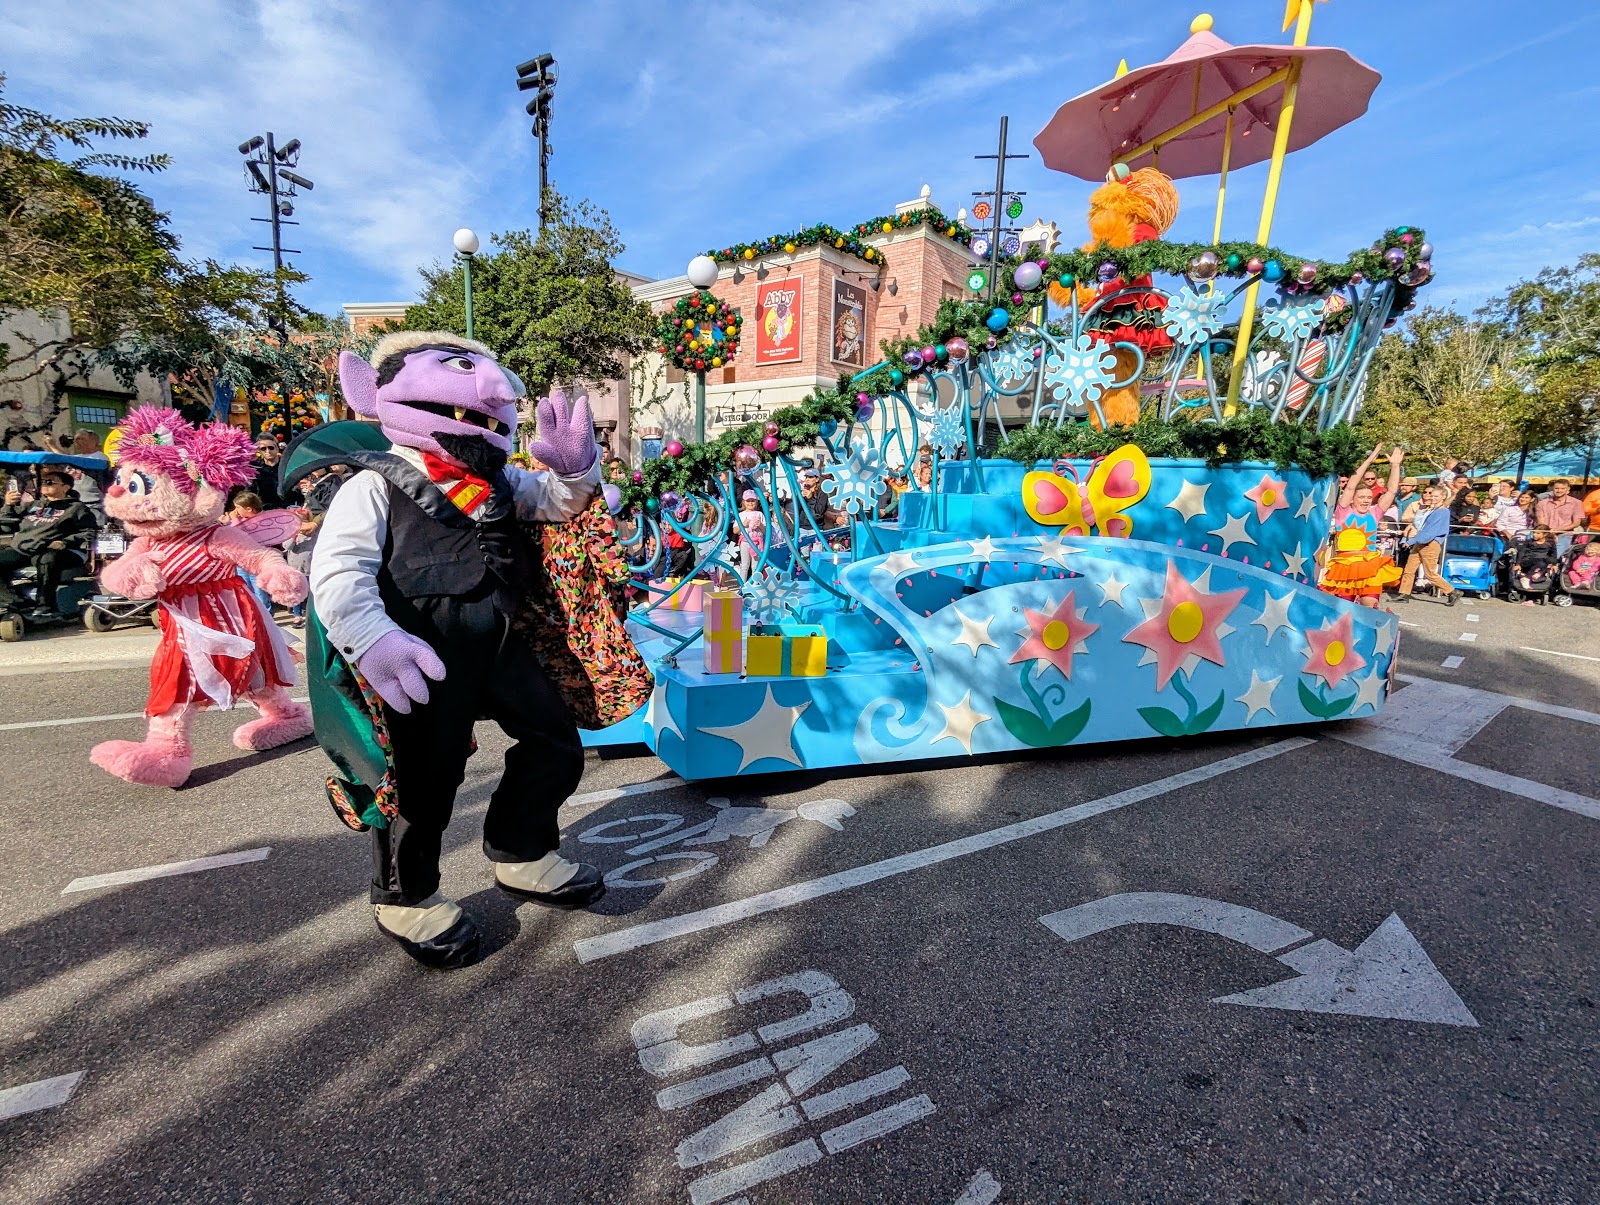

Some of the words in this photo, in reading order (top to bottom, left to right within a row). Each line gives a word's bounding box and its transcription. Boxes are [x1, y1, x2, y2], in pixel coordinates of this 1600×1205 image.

[764, 290, 795, 308] Abby
[723, 414, 744, 422] STAG
[631, 970, 1001, 1205] ONL
